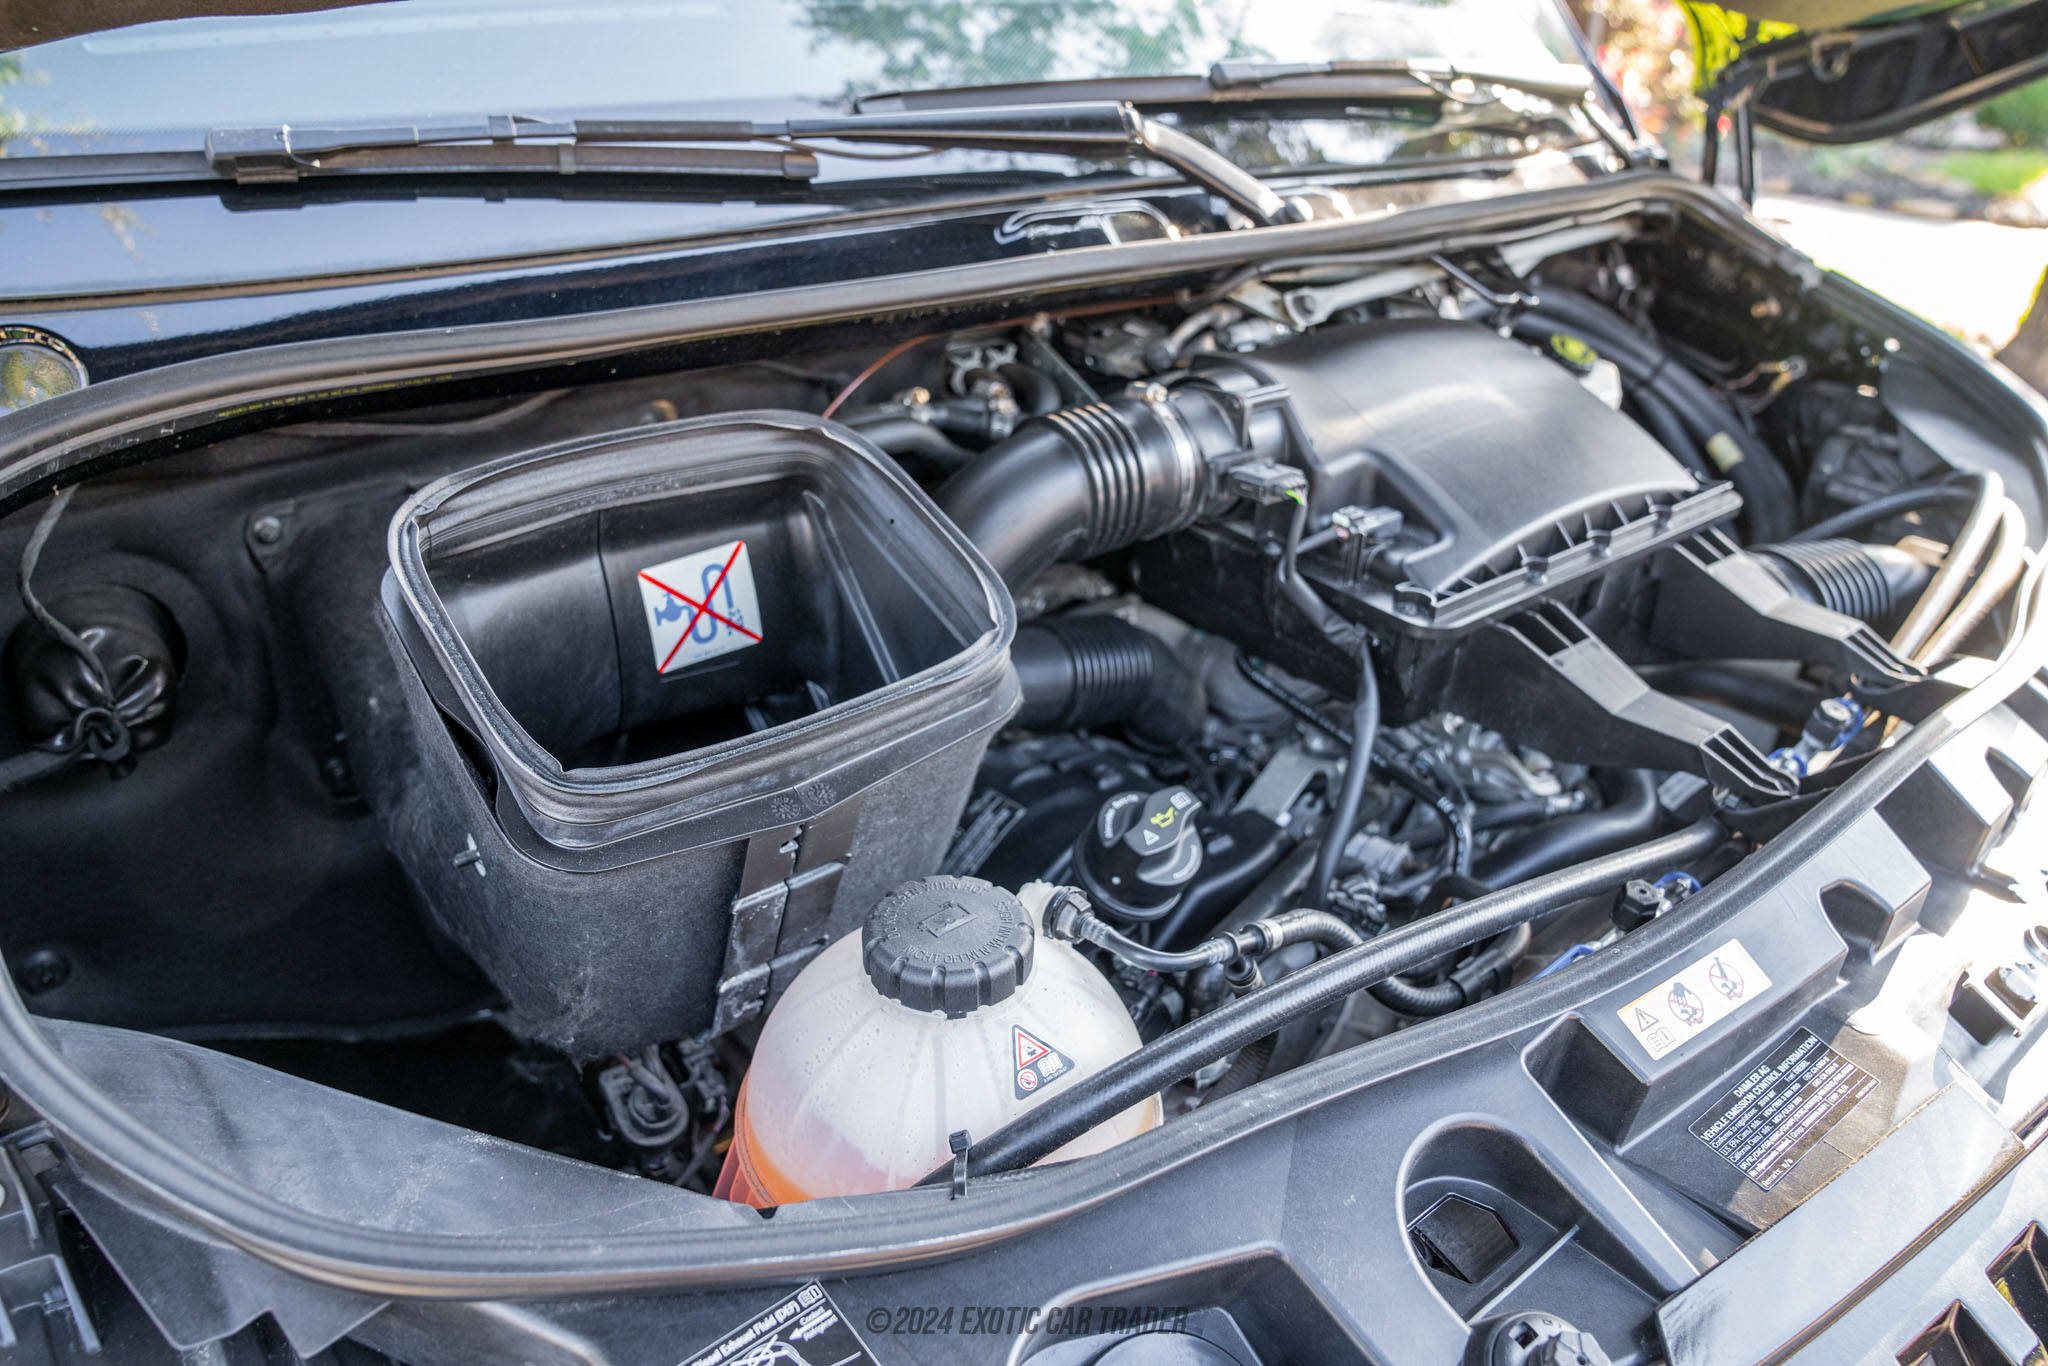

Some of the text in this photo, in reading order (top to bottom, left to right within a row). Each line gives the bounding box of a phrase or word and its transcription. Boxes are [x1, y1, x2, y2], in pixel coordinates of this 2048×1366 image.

[892, 887, 921, 906] OPEN
[922, 881, 961, 894] WHEN
[964, 882, 989, 896] HOT
[903, 945, 940, 962] NICHT
[1700, 1035, 1818, 1142] VEHICLE EMISSION CONTROL INFORMATION
[1733, 1064, 1771, 1097] DAIMLER AG
[720, 1328, 757, 1357] Exhaust
[752, 1314, 778, 1335] Fluid
[774, 1300, 800, 1323] (DEF)
